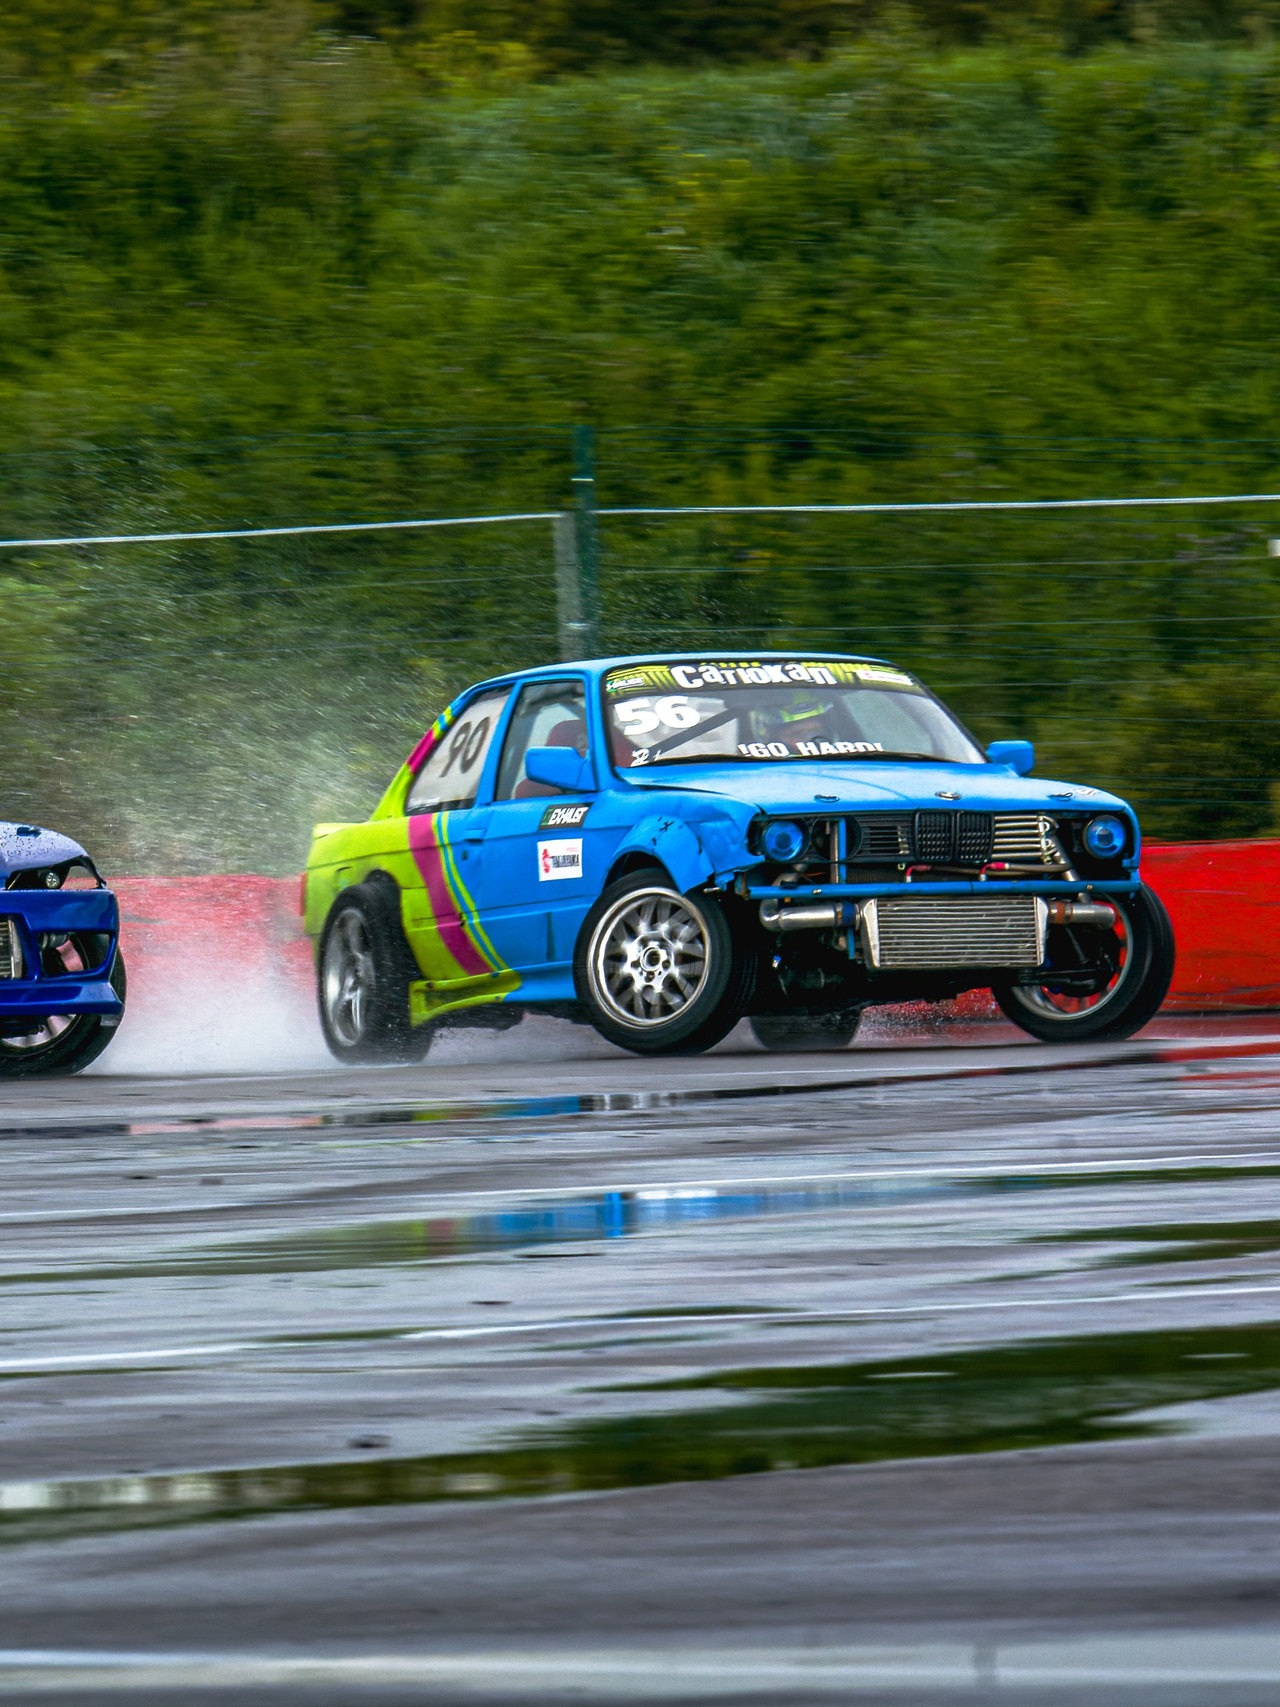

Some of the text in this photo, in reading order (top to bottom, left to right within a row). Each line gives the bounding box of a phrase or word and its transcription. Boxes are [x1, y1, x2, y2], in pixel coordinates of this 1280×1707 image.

[614, 695, 701, 736] 56
[439, 716, 491, 778] 90
[548, 807, 589, 825] EXHAUST
